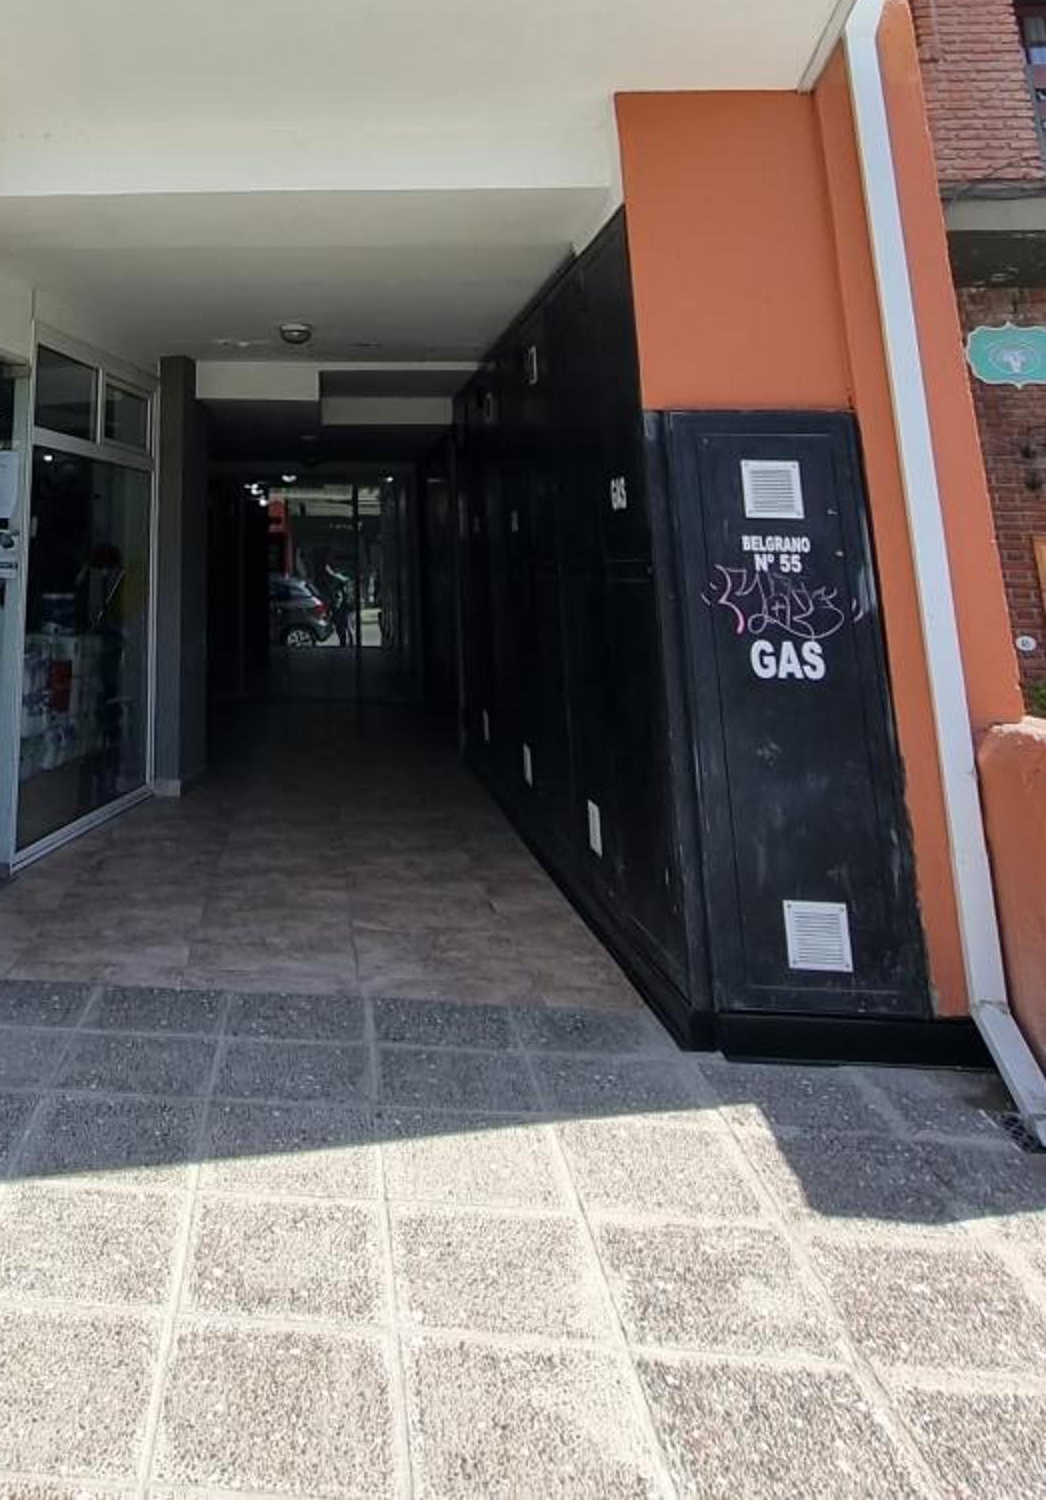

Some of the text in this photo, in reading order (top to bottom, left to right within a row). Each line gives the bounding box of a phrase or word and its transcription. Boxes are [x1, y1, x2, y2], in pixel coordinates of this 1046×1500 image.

[609, 476, 628, 511] GAS
[740, 534, 812, 553] BELGRANO
[779, 553, 803, 574] 55
[749, 638, 827, 681] GAS
